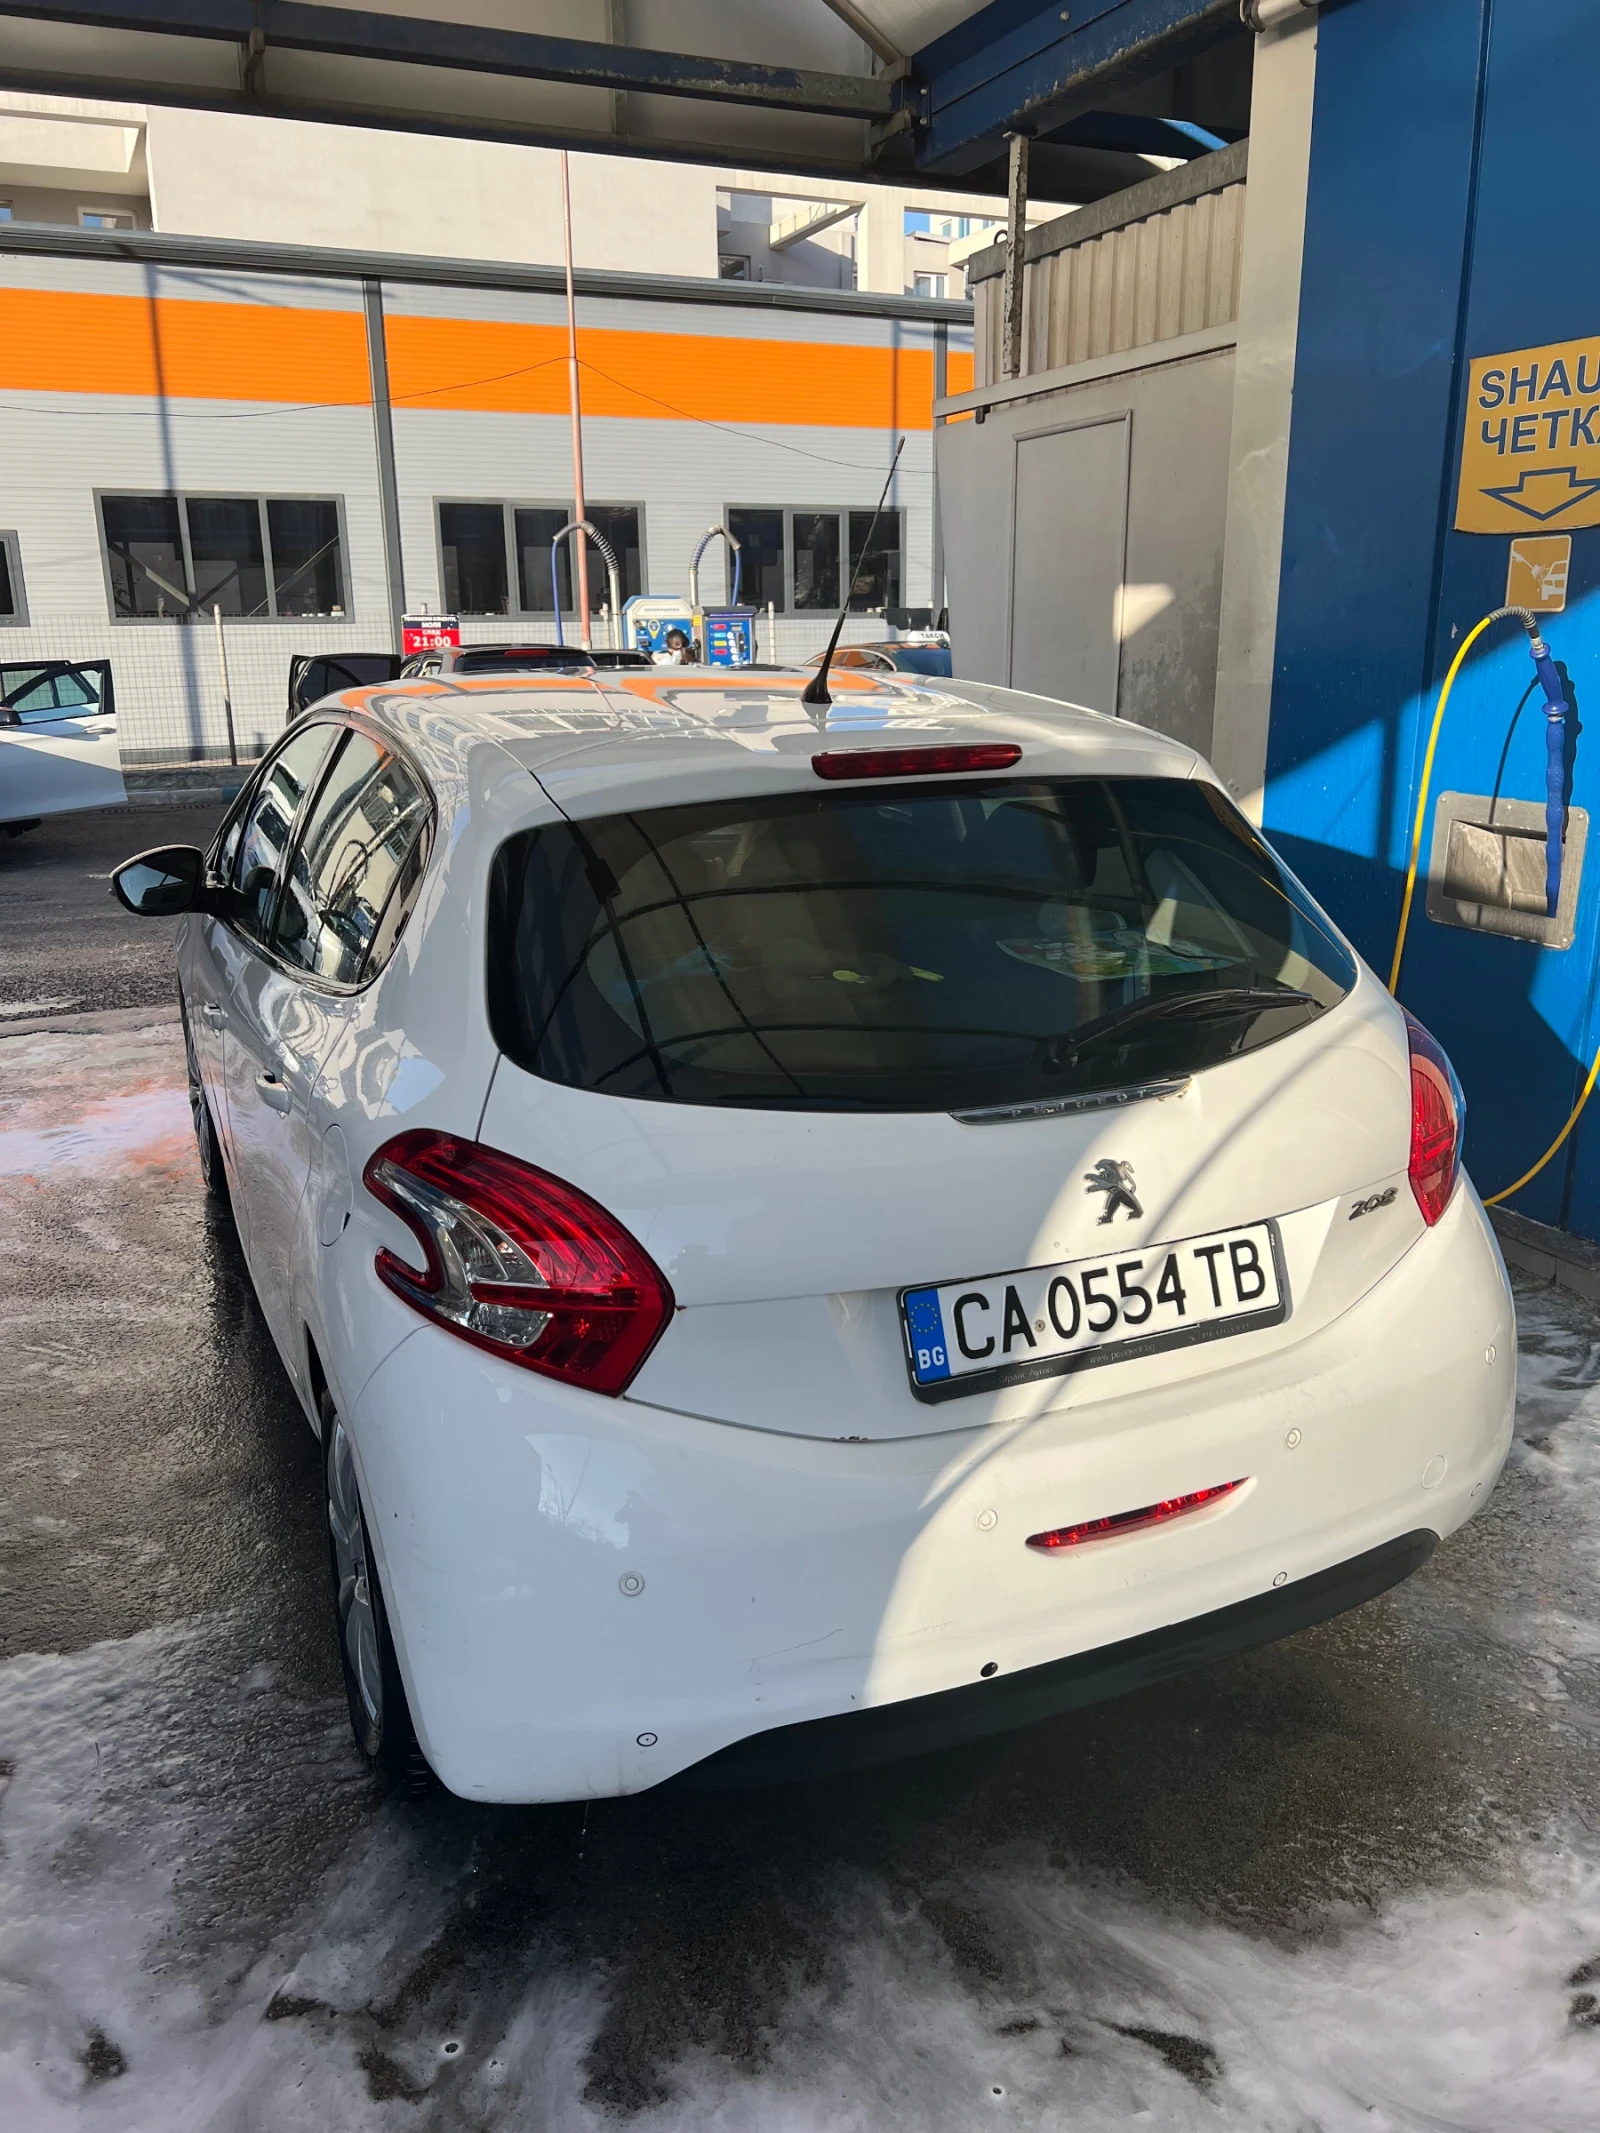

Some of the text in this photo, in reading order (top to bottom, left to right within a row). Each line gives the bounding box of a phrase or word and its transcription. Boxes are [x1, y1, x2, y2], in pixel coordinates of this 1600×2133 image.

[1481, 404, 1600, 456] ЧЕТК
[413, 636, 452, 647] 21:00
[1348, 1186, 1399, 1221] 208
[953, 1238, 1266, 1360] CA 0554 TB
[917, 1346, 946, 1370] BG
